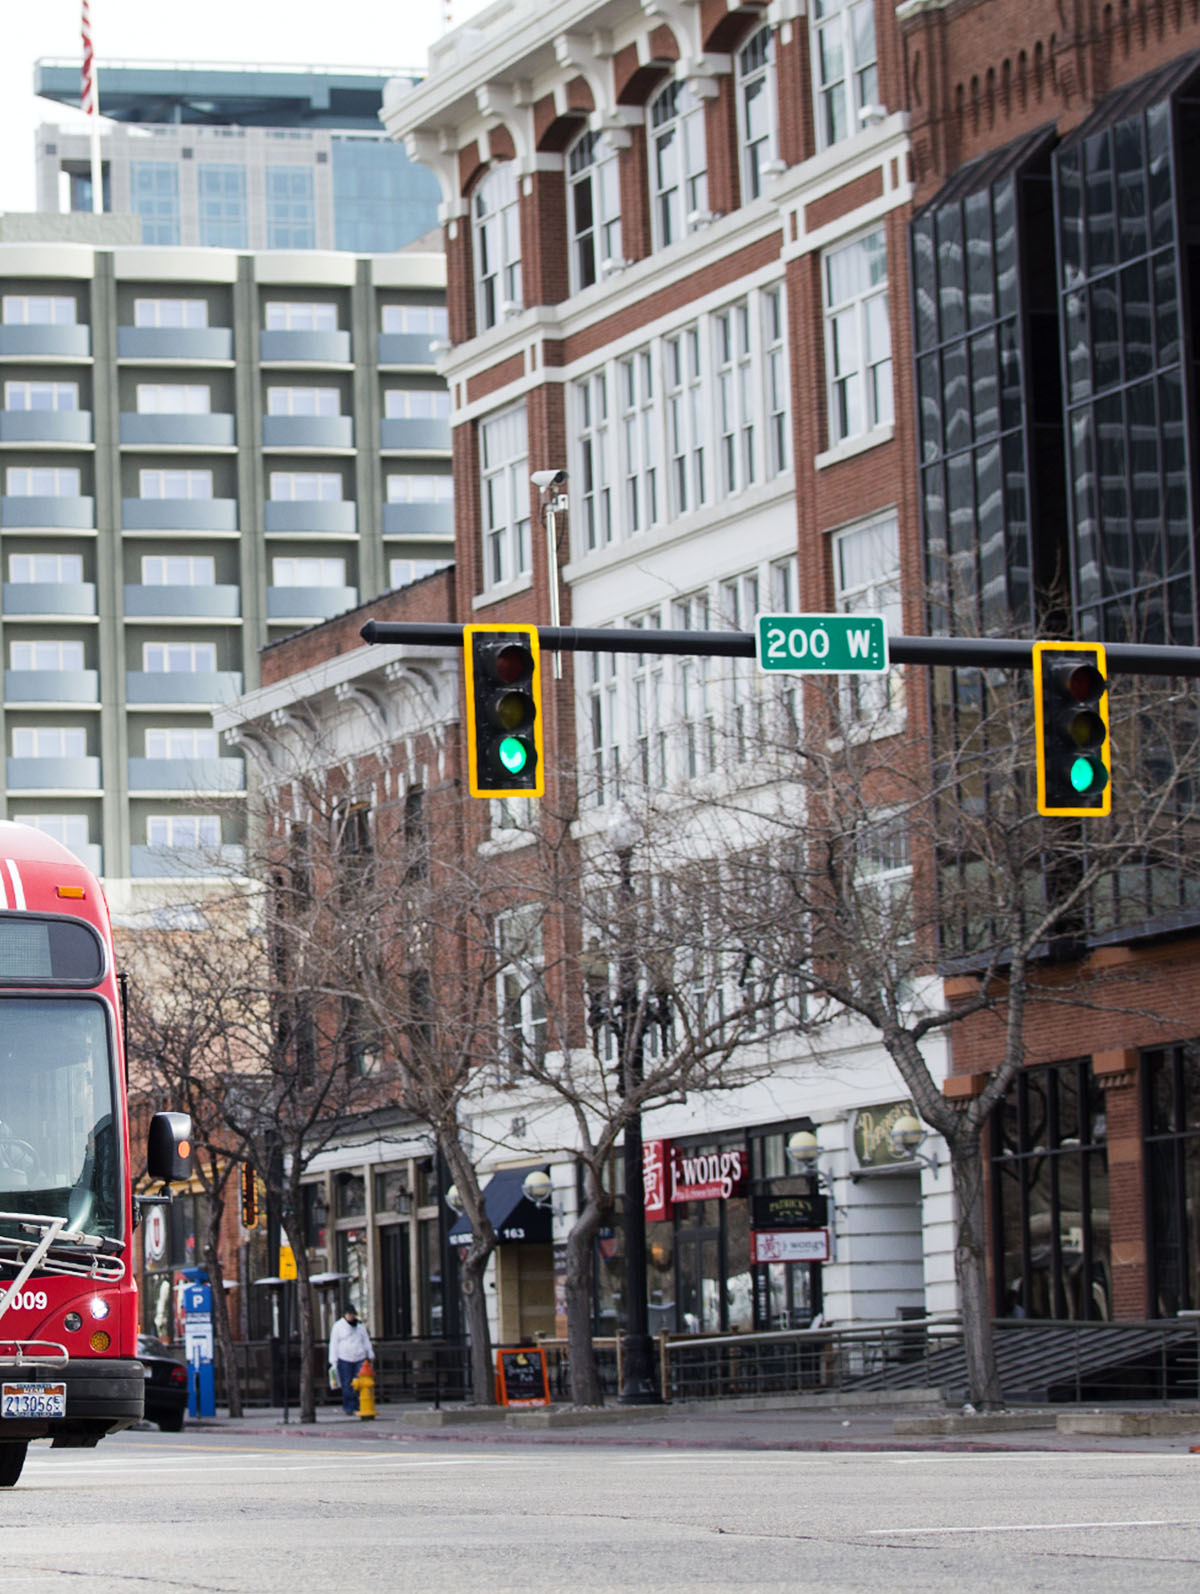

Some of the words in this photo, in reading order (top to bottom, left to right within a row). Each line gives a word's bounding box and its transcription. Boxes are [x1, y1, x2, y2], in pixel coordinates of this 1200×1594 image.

[767, 629, 830, 658] 200
[503, 1228, 525, 1239] 163
[193, 1295, 204, 1309] P
[6, 1396, 53, 1412] 213056
